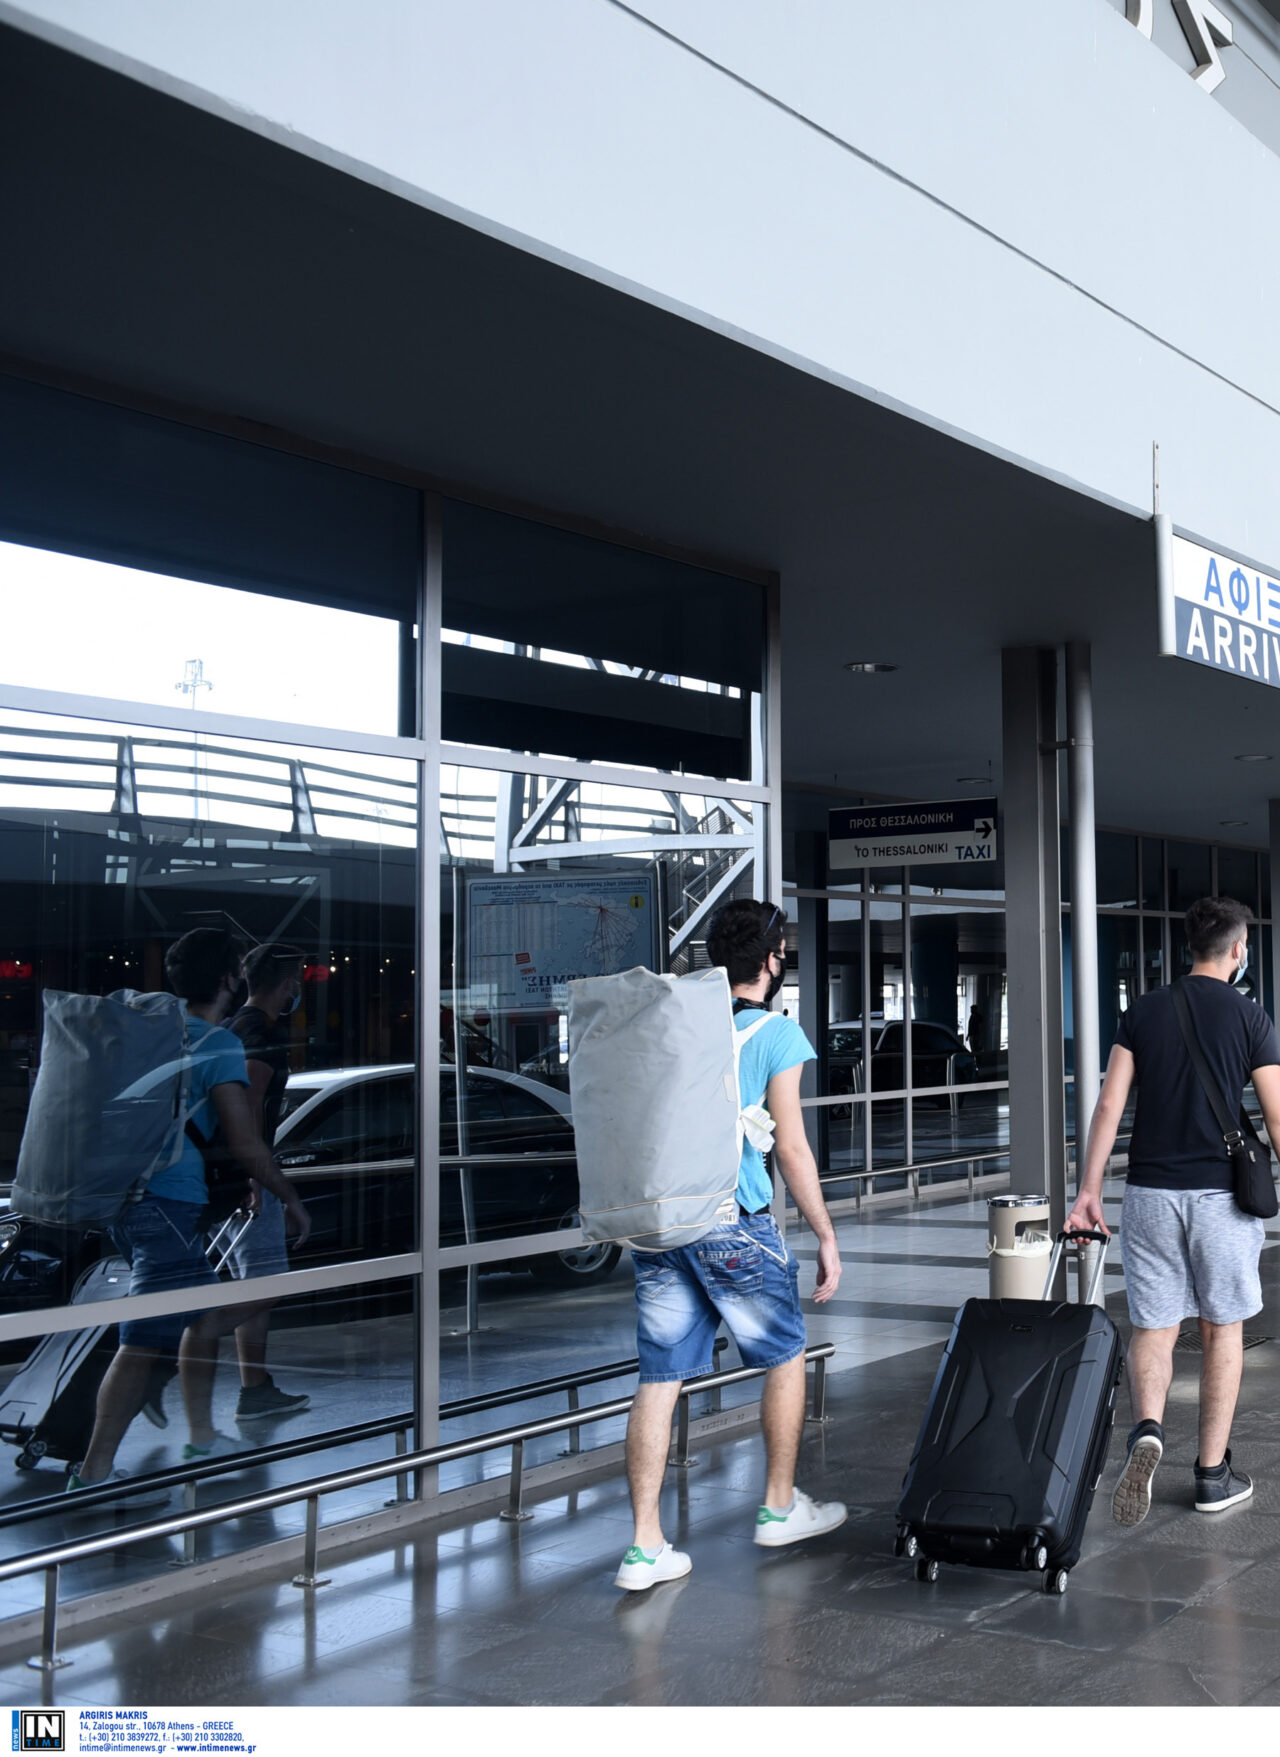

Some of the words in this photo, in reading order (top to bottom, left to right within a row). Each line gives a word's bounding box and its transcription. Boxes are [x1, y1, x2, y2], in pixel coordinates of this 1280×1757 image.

[849, 817, 877, 830] ΠΡΟΣ
[879, 812, 954, 827] ΘΕΣΣΑΛΟΝΙΚΗ
[855, 845, 869, 858] TO
[872, 843, 948, 857] THESSALONIKI
[955, 844, 991, 860] TAXI
